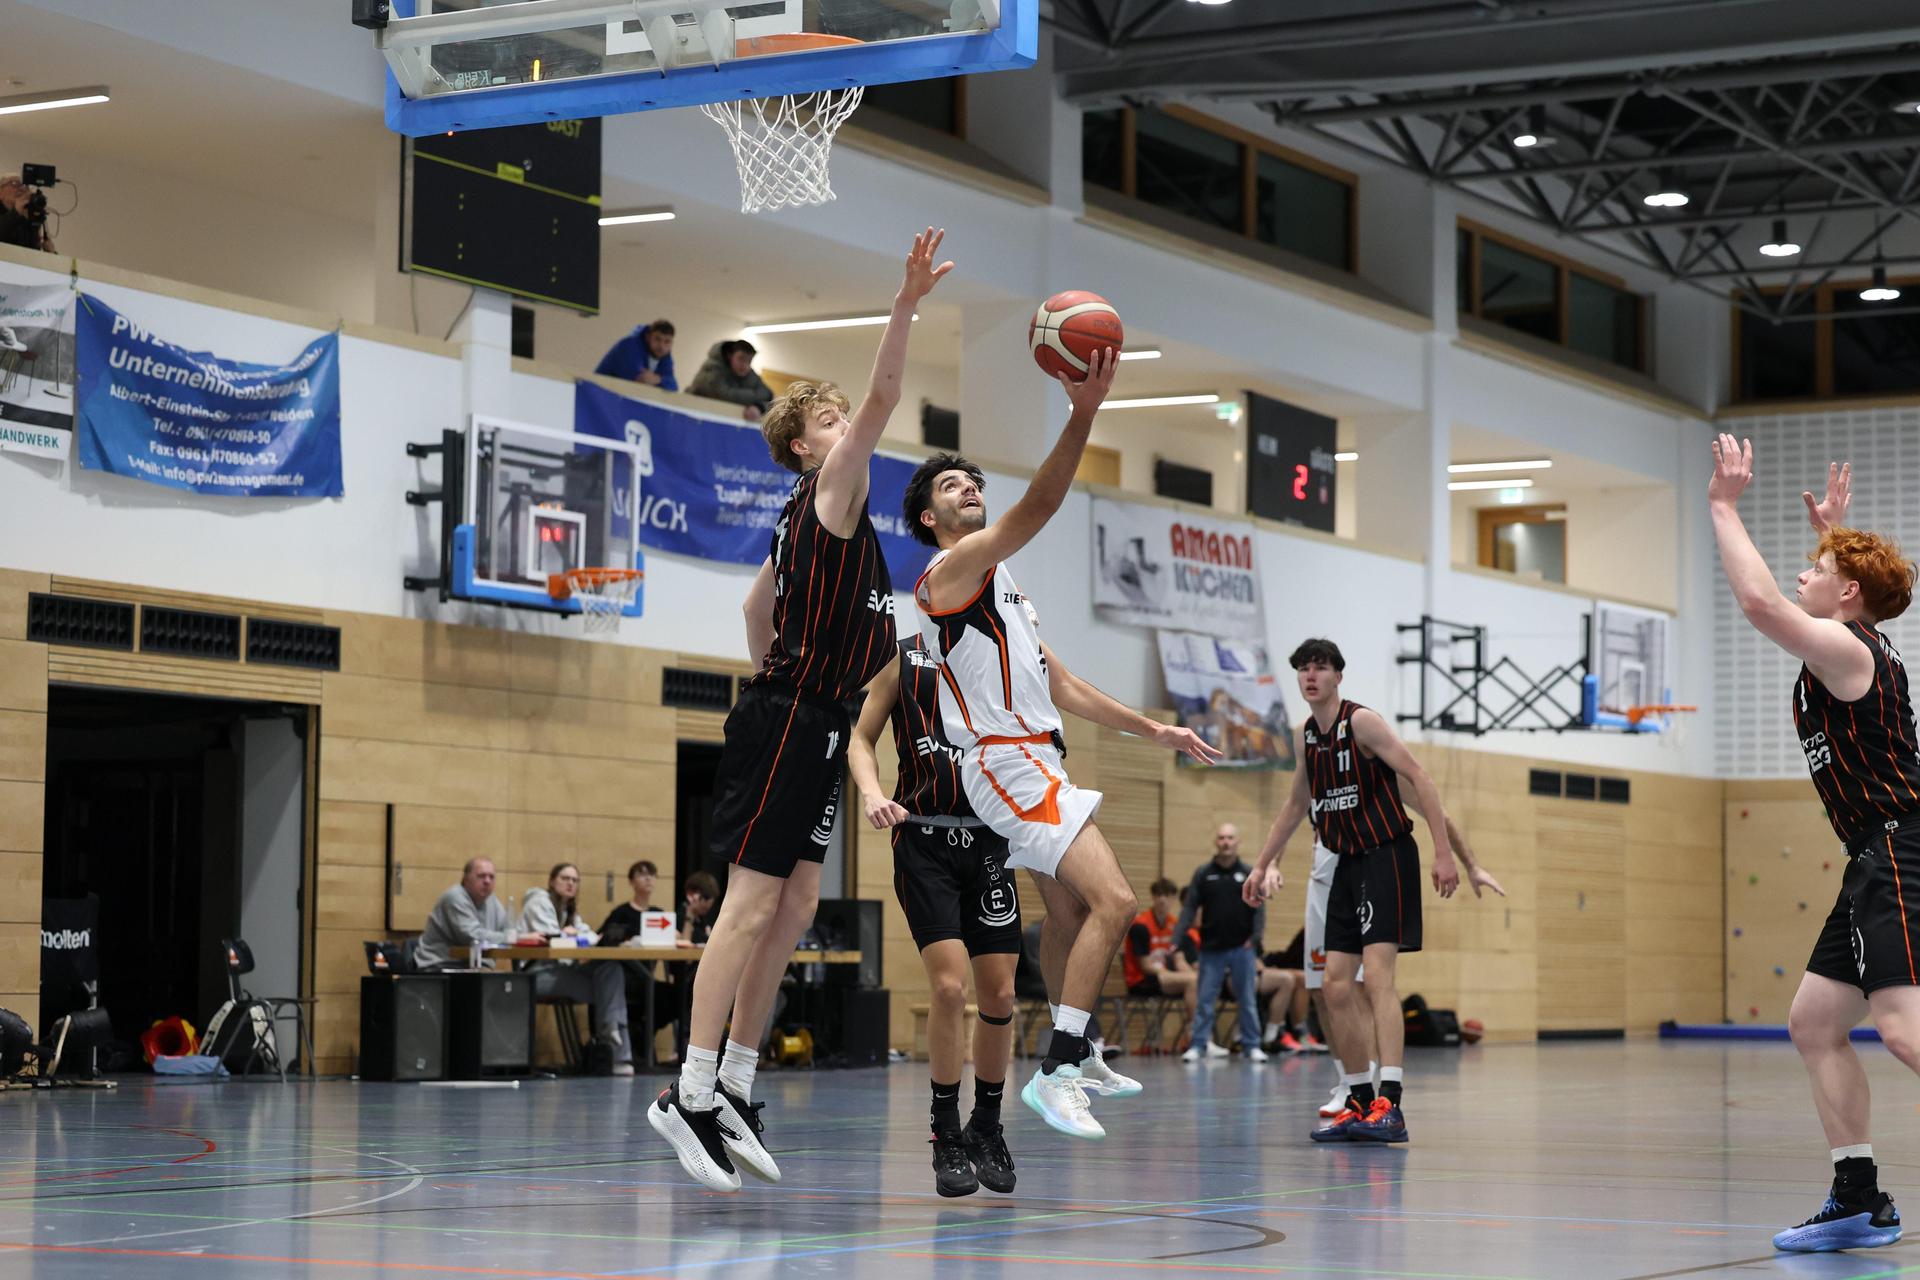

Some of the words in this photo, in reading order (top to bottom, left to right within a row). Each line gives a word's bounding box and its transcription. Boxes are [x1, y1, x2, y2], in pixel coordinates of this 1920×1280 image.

[153, 418, 182, 436] Tel.:
[150, 440, 174, 458] Fax:
[1293, 464, 1308, 500] 2
[1337, 749, 1350, 772] 11
[821, 771, 841, 827] FDTec
[40, 928, 90, 950] molten
